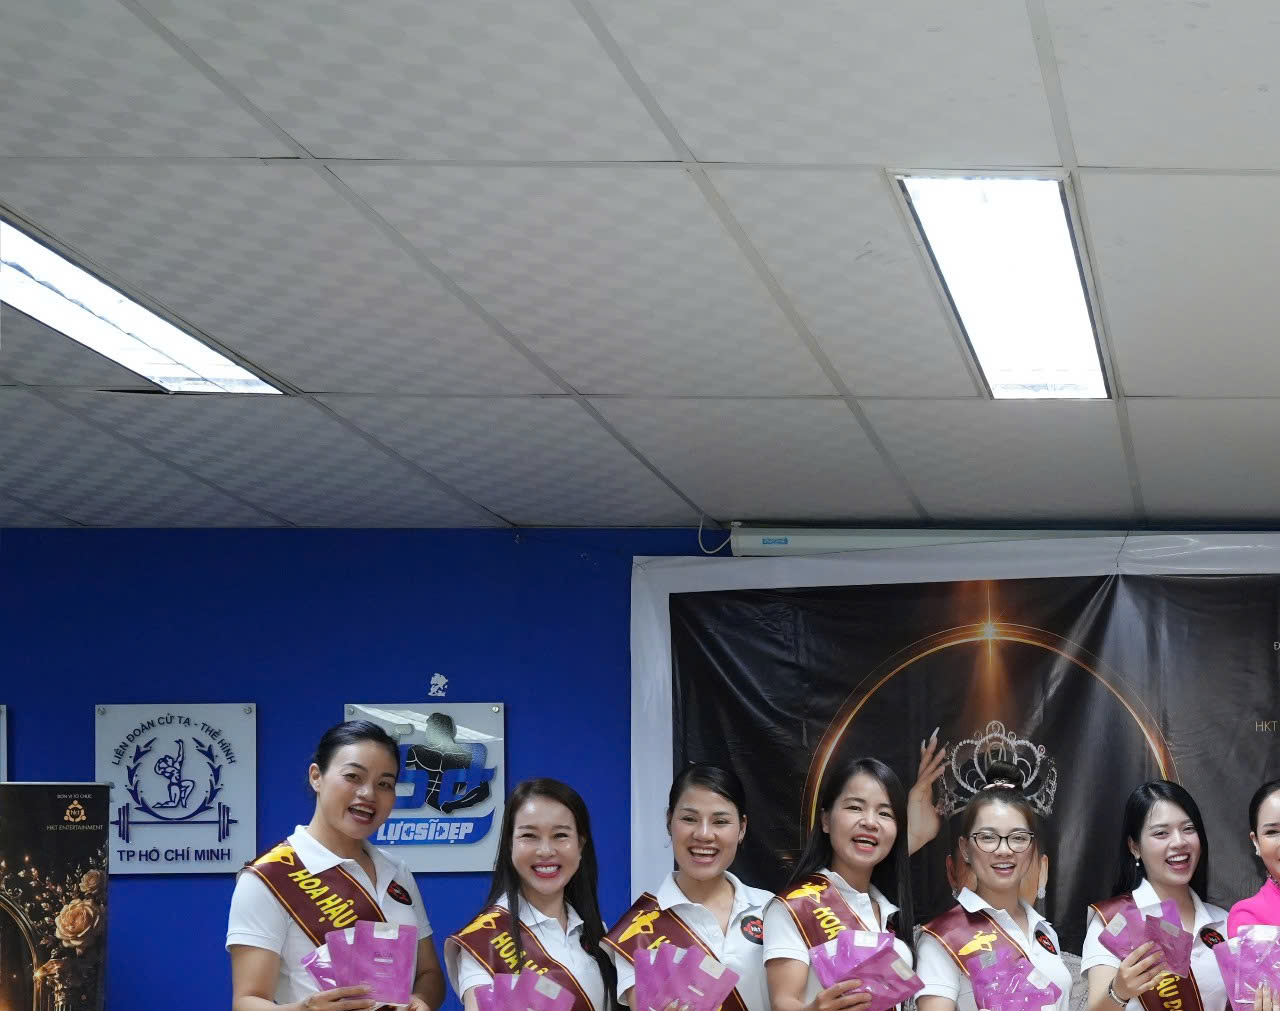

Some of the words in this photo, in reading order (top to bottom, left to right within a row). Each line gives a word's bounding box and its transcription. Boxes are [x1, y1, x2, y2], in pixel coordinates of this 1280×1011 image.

[112, 742, 130, 766] LIÊN
[126, 719, 156, 743] ĐOÀN
[177, 715, 192, 728] TẠ
[1255, 720, 1278, 732] HKT
[117, 850, 136, 862] TP
[164, 846, 191, 862] CHÍ
[195, 849, 232, 861] MINH
[288, 869, 330, 906] HOA
[318, 893, 358, 929] HẬU
[813, 906, 847, 941] HOA
